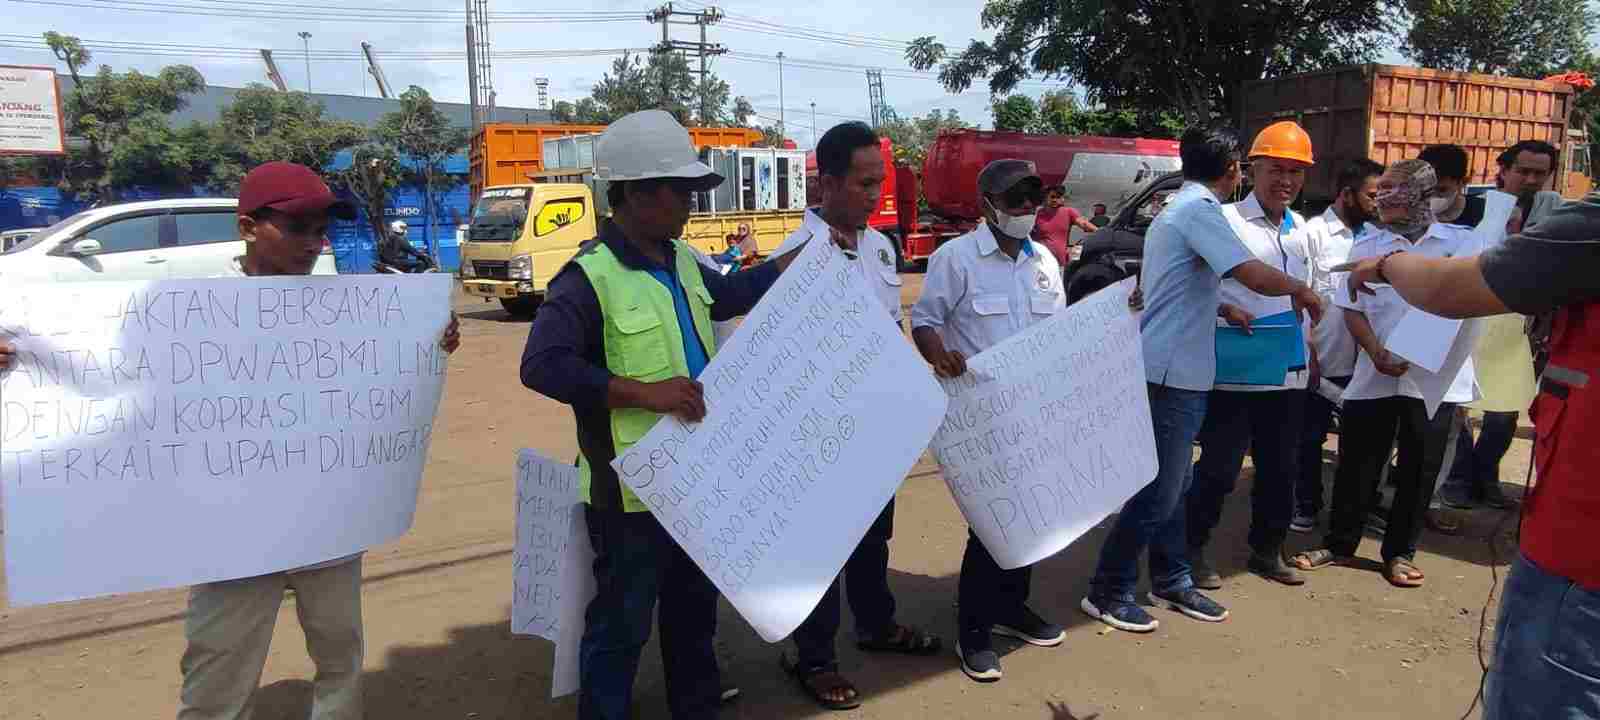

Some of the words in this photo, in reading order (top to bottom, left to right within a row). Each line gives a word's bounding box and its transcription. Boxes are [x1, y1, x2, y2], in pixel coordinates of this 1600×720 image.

[258, 285, 405, 329] BERSAMA
[174, 391, 306, 434] KOPRASI
[320, 387, 412, 421] TKBM
[775, 359, 824, 418] HANYA
[205, 438, 306, 477] UPAH
[987, 443, 1120, 544] PIDANA
